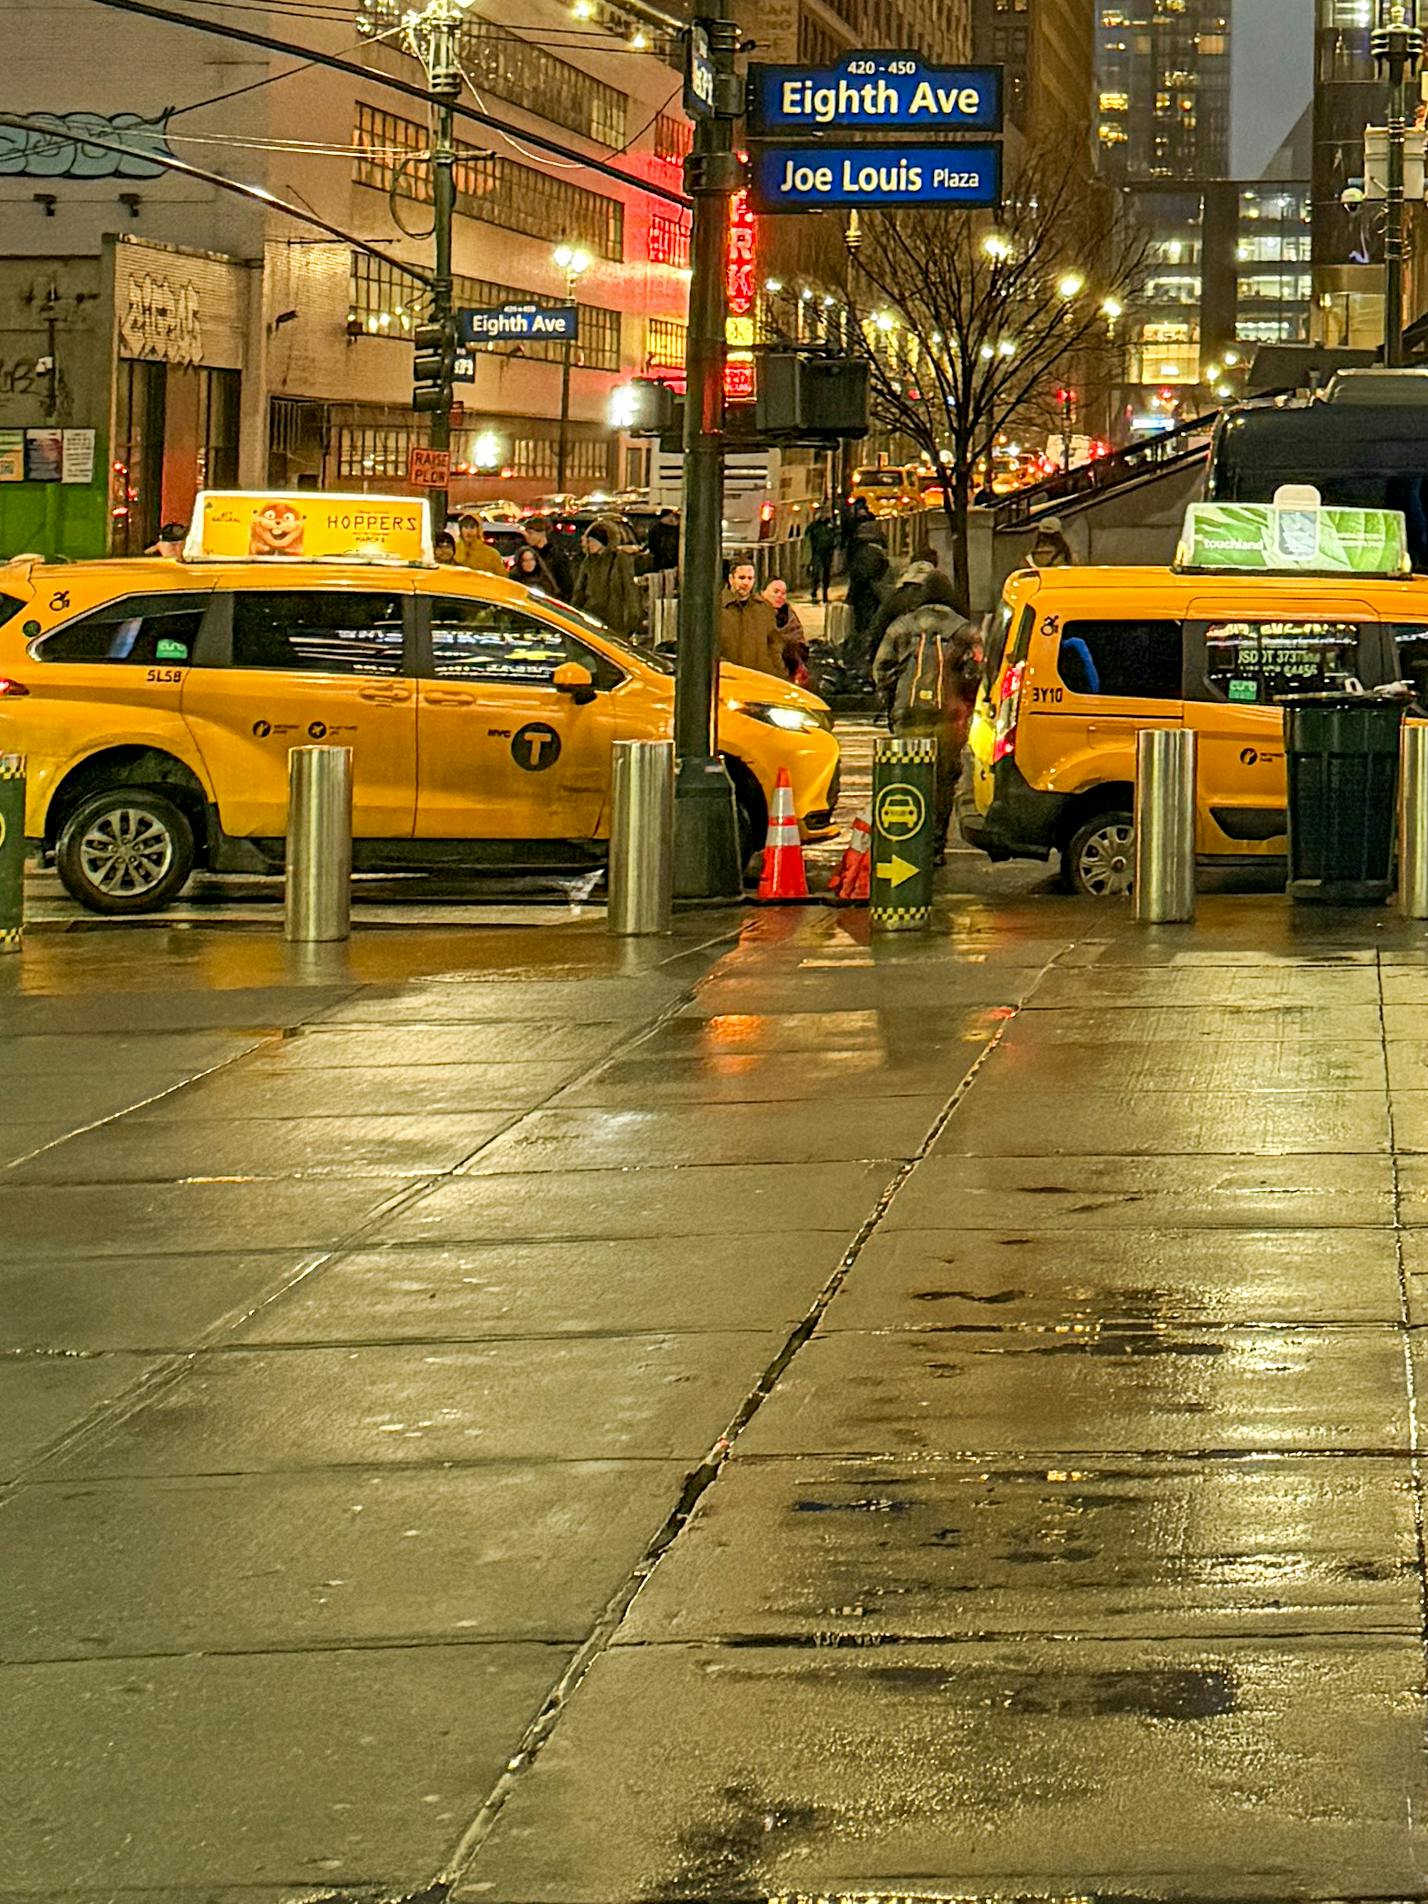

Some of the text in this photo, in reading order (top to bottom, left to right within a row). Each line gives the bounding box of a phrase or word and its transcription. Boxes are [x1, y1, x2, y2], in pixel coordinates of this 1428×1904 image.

[847, 60, 876, 75] 420
[887, 60, 916, 75] 450
[782, 79, 980, 123] Eighth Ave
[780, 158, 979, 191] Joe Louis Plaza
[472, 314, 566, 336] Eighth Ave
[415, 451, 448, 467] RAISE
[327, 515, 417, 531] HOPPERS
[1203, 539, 1264, 550] touchland
[523, 732, 552, 765] T
